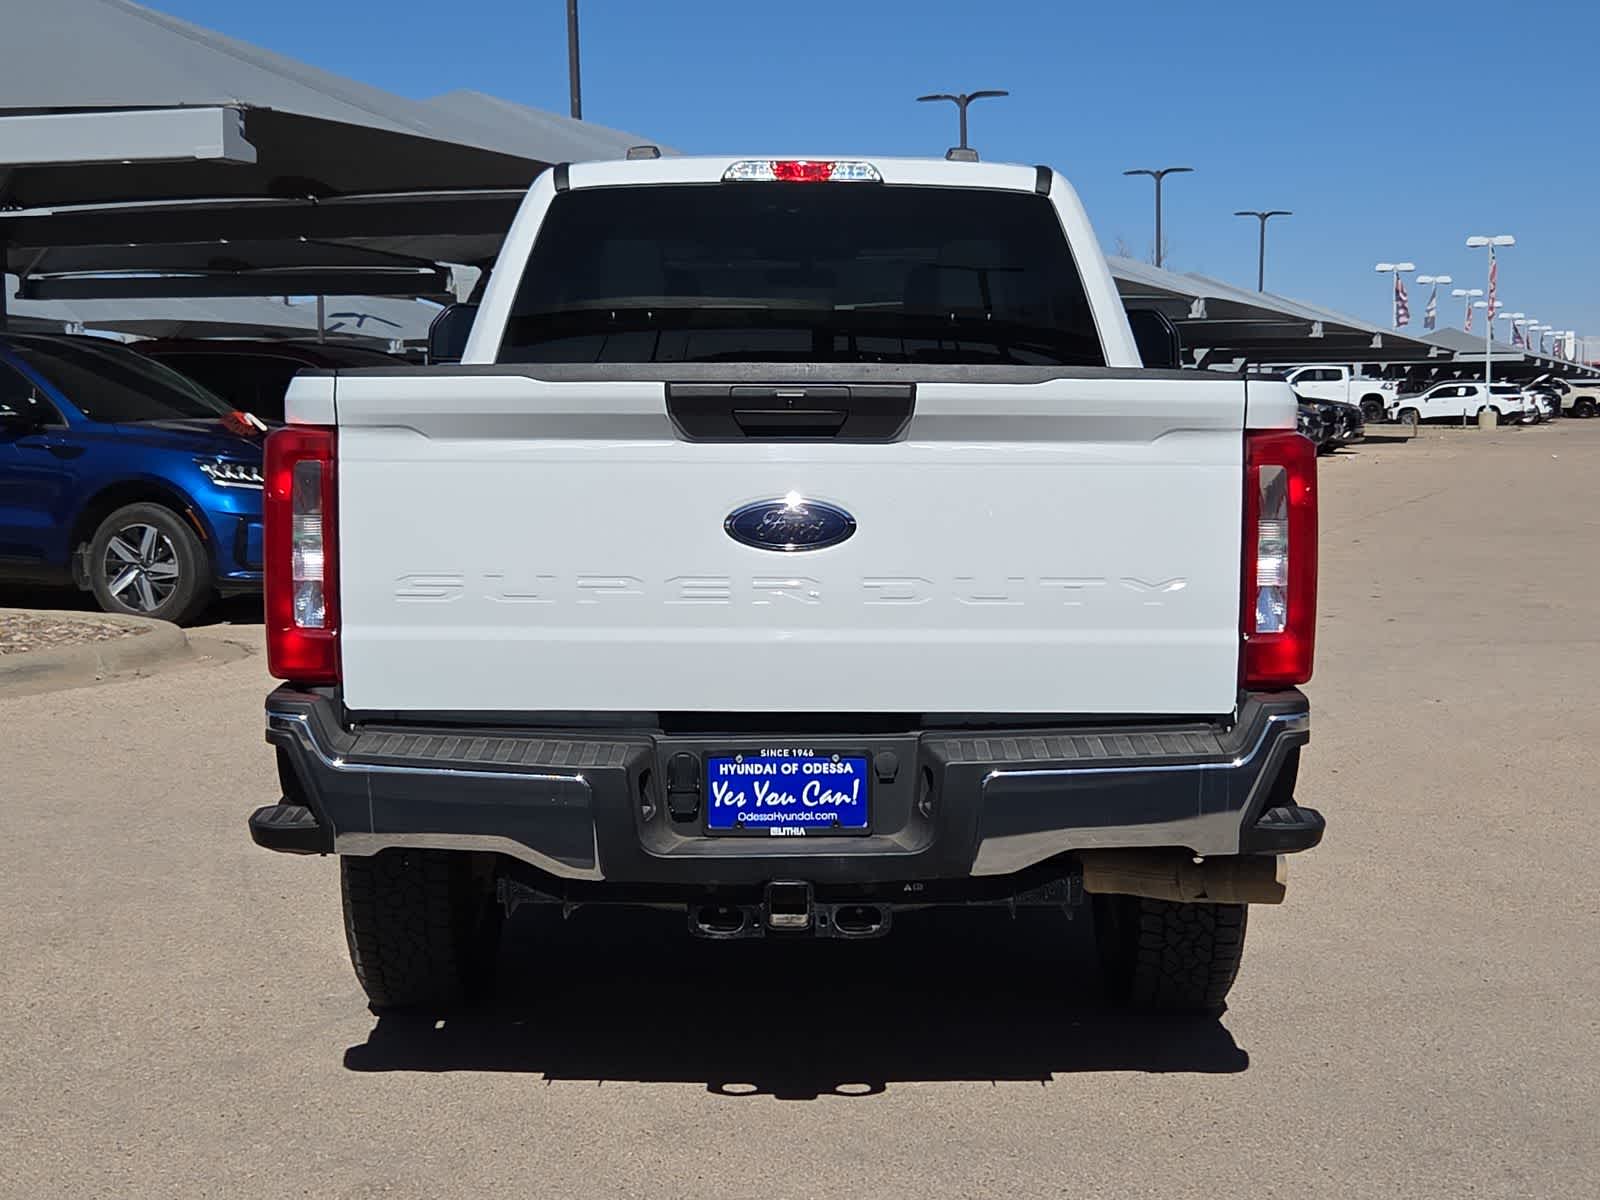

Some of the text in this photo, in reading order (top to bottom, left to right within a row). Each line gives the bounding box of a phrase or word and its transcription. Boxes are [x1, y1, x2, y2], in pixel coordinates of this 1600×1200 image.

[393, 573, 1188, 606] SUPER DUTY
[760, 749, 815, 757] SINCE 1946
[719, 762, 854, 775] HYUNDAI OF ODESSA
[712, 778, 860, 808] Yes You Can!
[737, 811, 838, 823] OdessaHyundai.com
